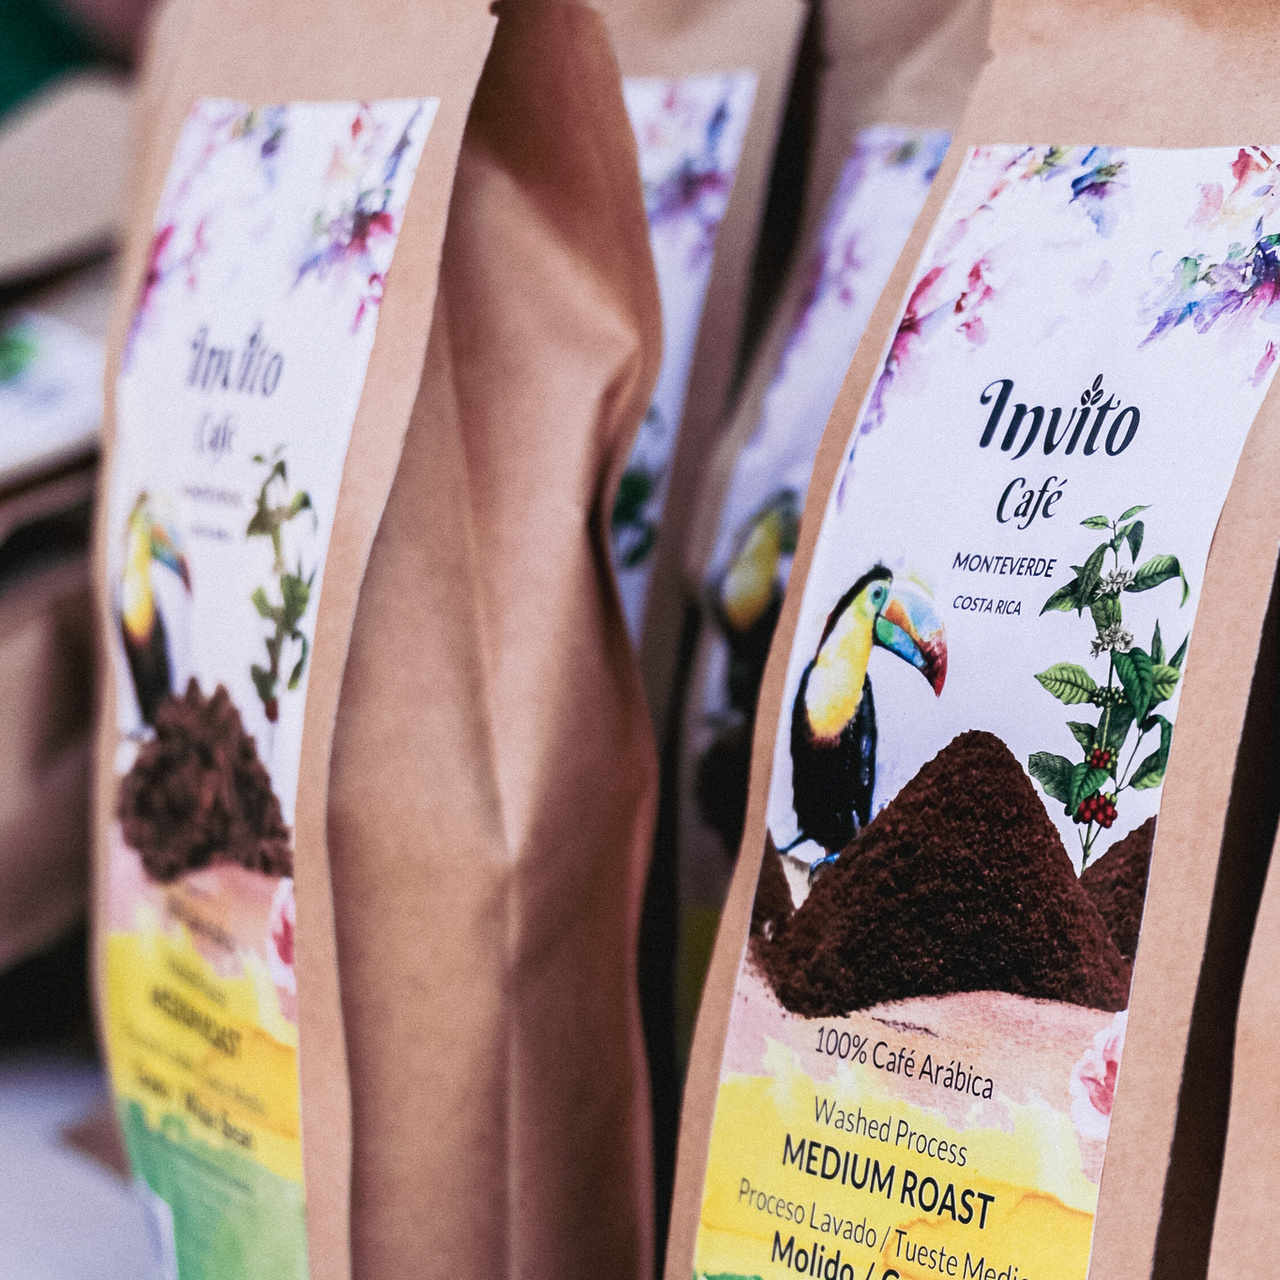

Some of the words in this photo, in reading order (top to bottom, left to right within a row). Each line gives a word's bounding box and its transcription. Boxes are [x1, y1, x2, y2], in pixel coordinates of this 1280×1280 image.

[979, 374, 1141, 460] Invito
[996, 476, 1068, 530] Café
[952, 552, 1057, 578] MONTEVERDE
[952, 594, 994, 614] COSTA
[995, 598, 1022, 616] RICA
[815, 1025, 869, 1064] 100%
[872, 1041, 916, 1078] Café
[918, 1054, 995, 1100] Arábica
[814, 1095, 892, 1143] Washed
[894, 1120, 968, 1167] Process
[782, 1133, 896, 1200] MEDIUM
[900, 1170, 996, 1230] ROAST
[737, 1177, 805, 1225] Proceso
[809, 1201, 877, 1249] Lavado
[879, 1225, 892, 1253] /
[894, 1228, 959, 1276] Tueste
